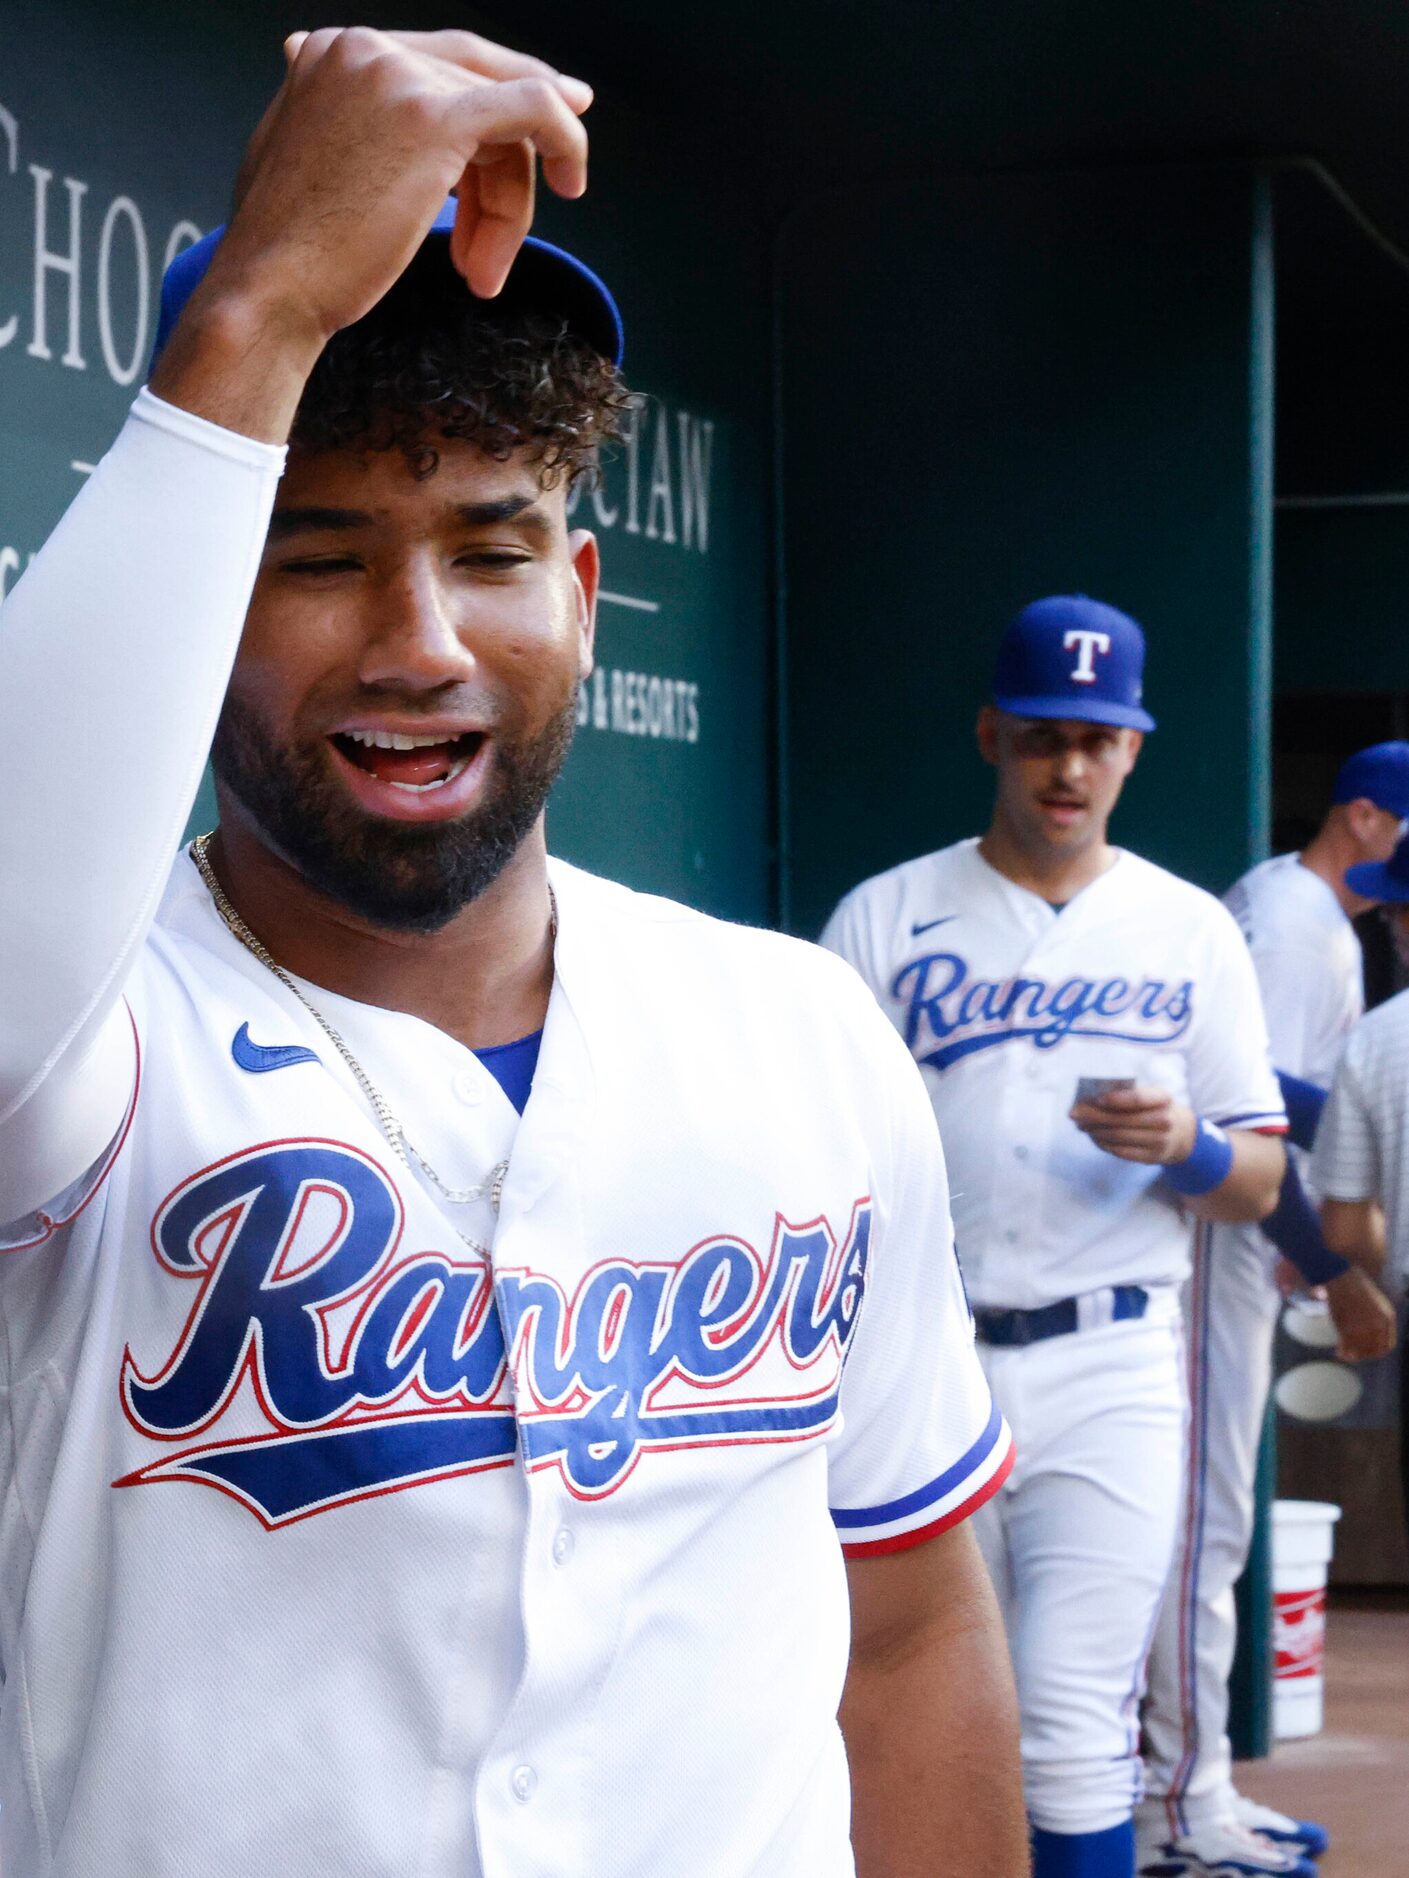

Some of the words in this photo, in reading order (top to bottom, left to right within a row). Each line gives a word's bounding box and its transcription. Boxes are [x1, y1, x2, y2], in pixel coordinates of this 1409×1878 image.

[1063, 631, 1110, 683] T
[611, 669, 699, 742] RESORTS
[892, 953, 1195, 1055] Rangers
[115, 1137, 872, 1510] Rangers
